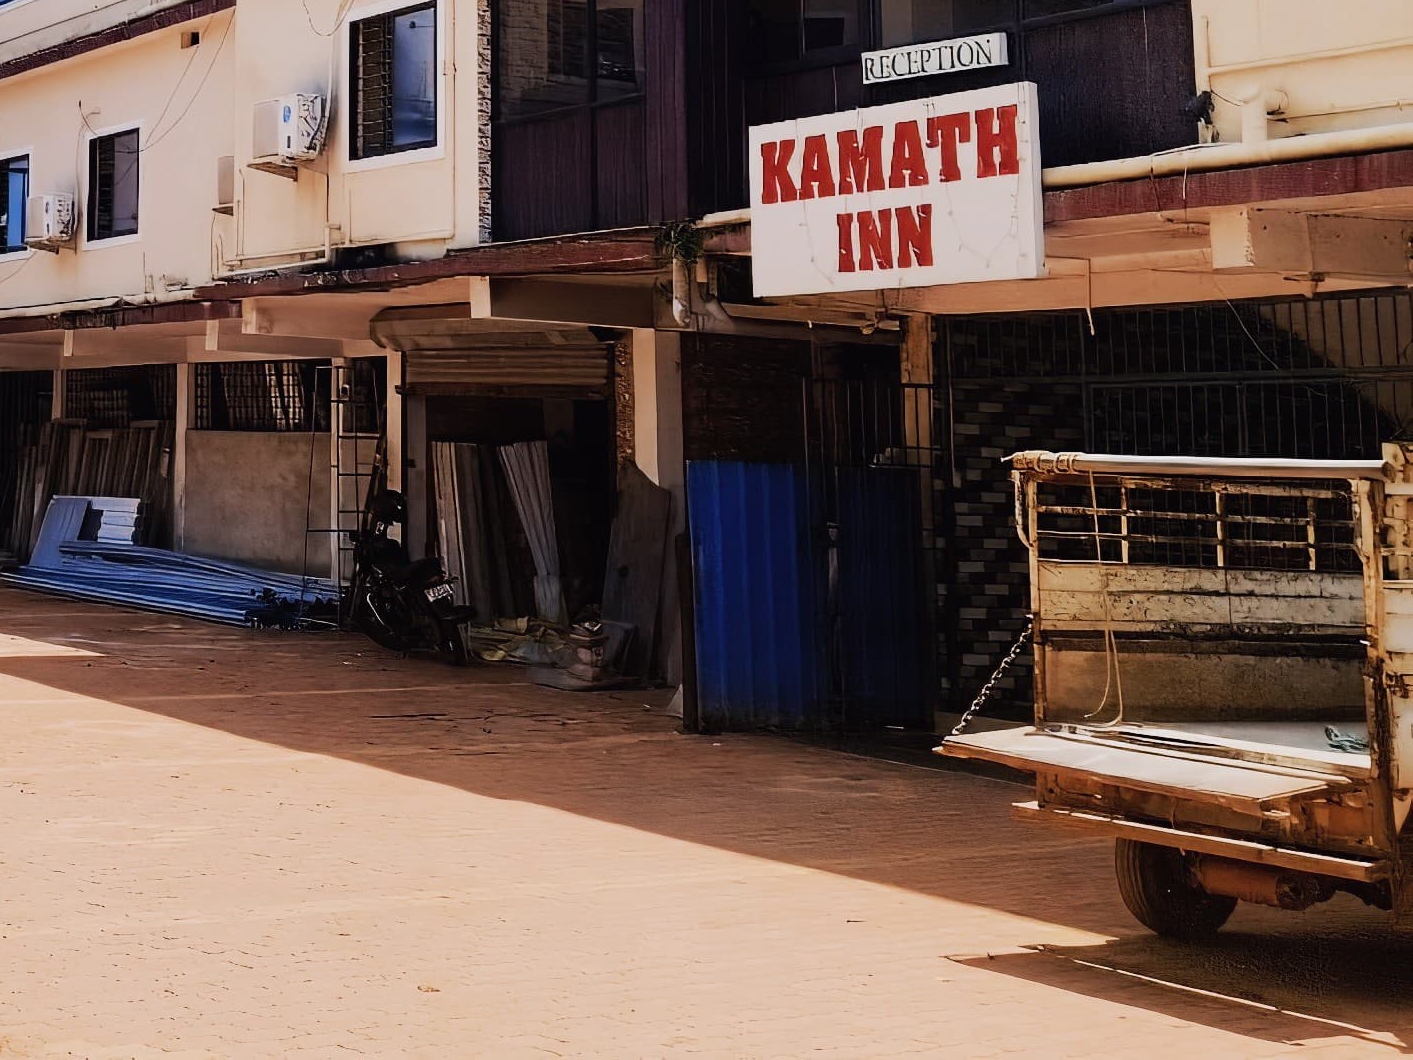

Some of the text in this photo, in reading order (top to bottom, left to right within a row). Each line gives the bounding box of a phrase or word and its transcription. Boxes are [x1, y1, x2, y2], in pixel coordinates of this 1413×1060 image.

[864, 39, 992, 80] RECEPTION
[761, 104, 1019, 204] KAMATH
[837, 204, 933, 272] INN
